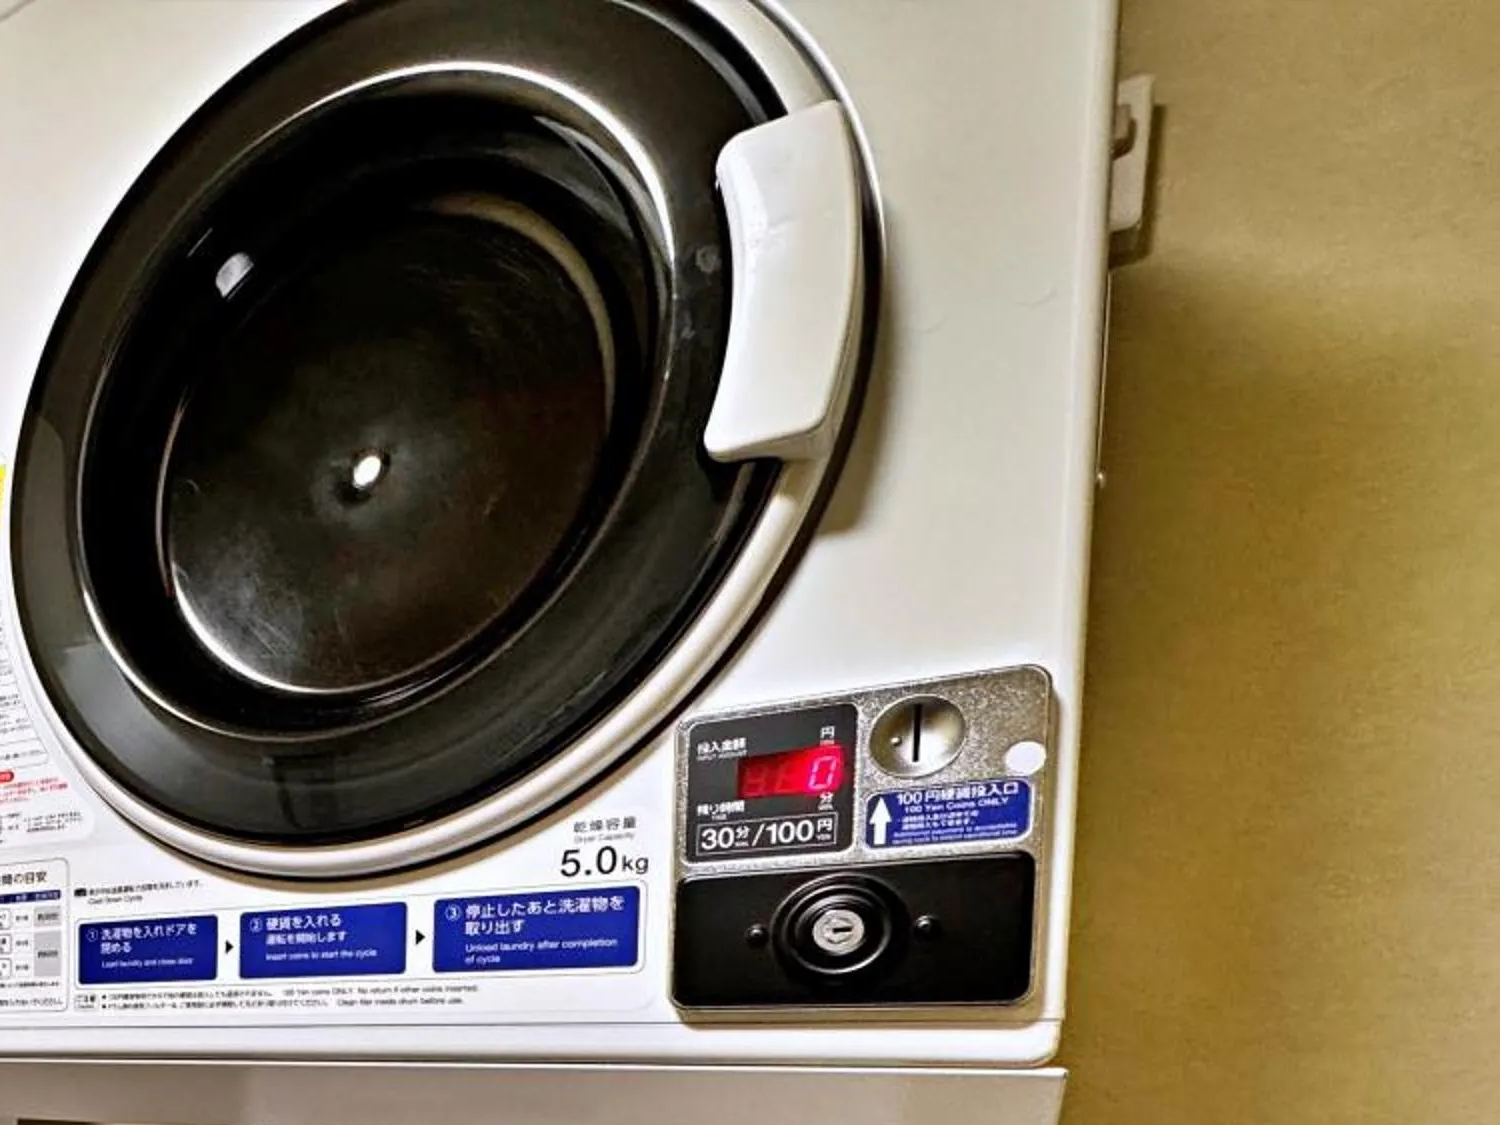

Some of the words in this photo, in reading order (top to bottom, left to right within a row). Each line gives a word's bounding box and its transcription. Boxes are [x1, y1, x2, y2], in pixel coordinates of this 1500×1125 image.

[465, 895, 624, 918] 停止したあと洗濯物を
[464, 919, 525, 936] 取り出す
[537, 939, 560, 949] after
[561, 937, 618, 950] completion
